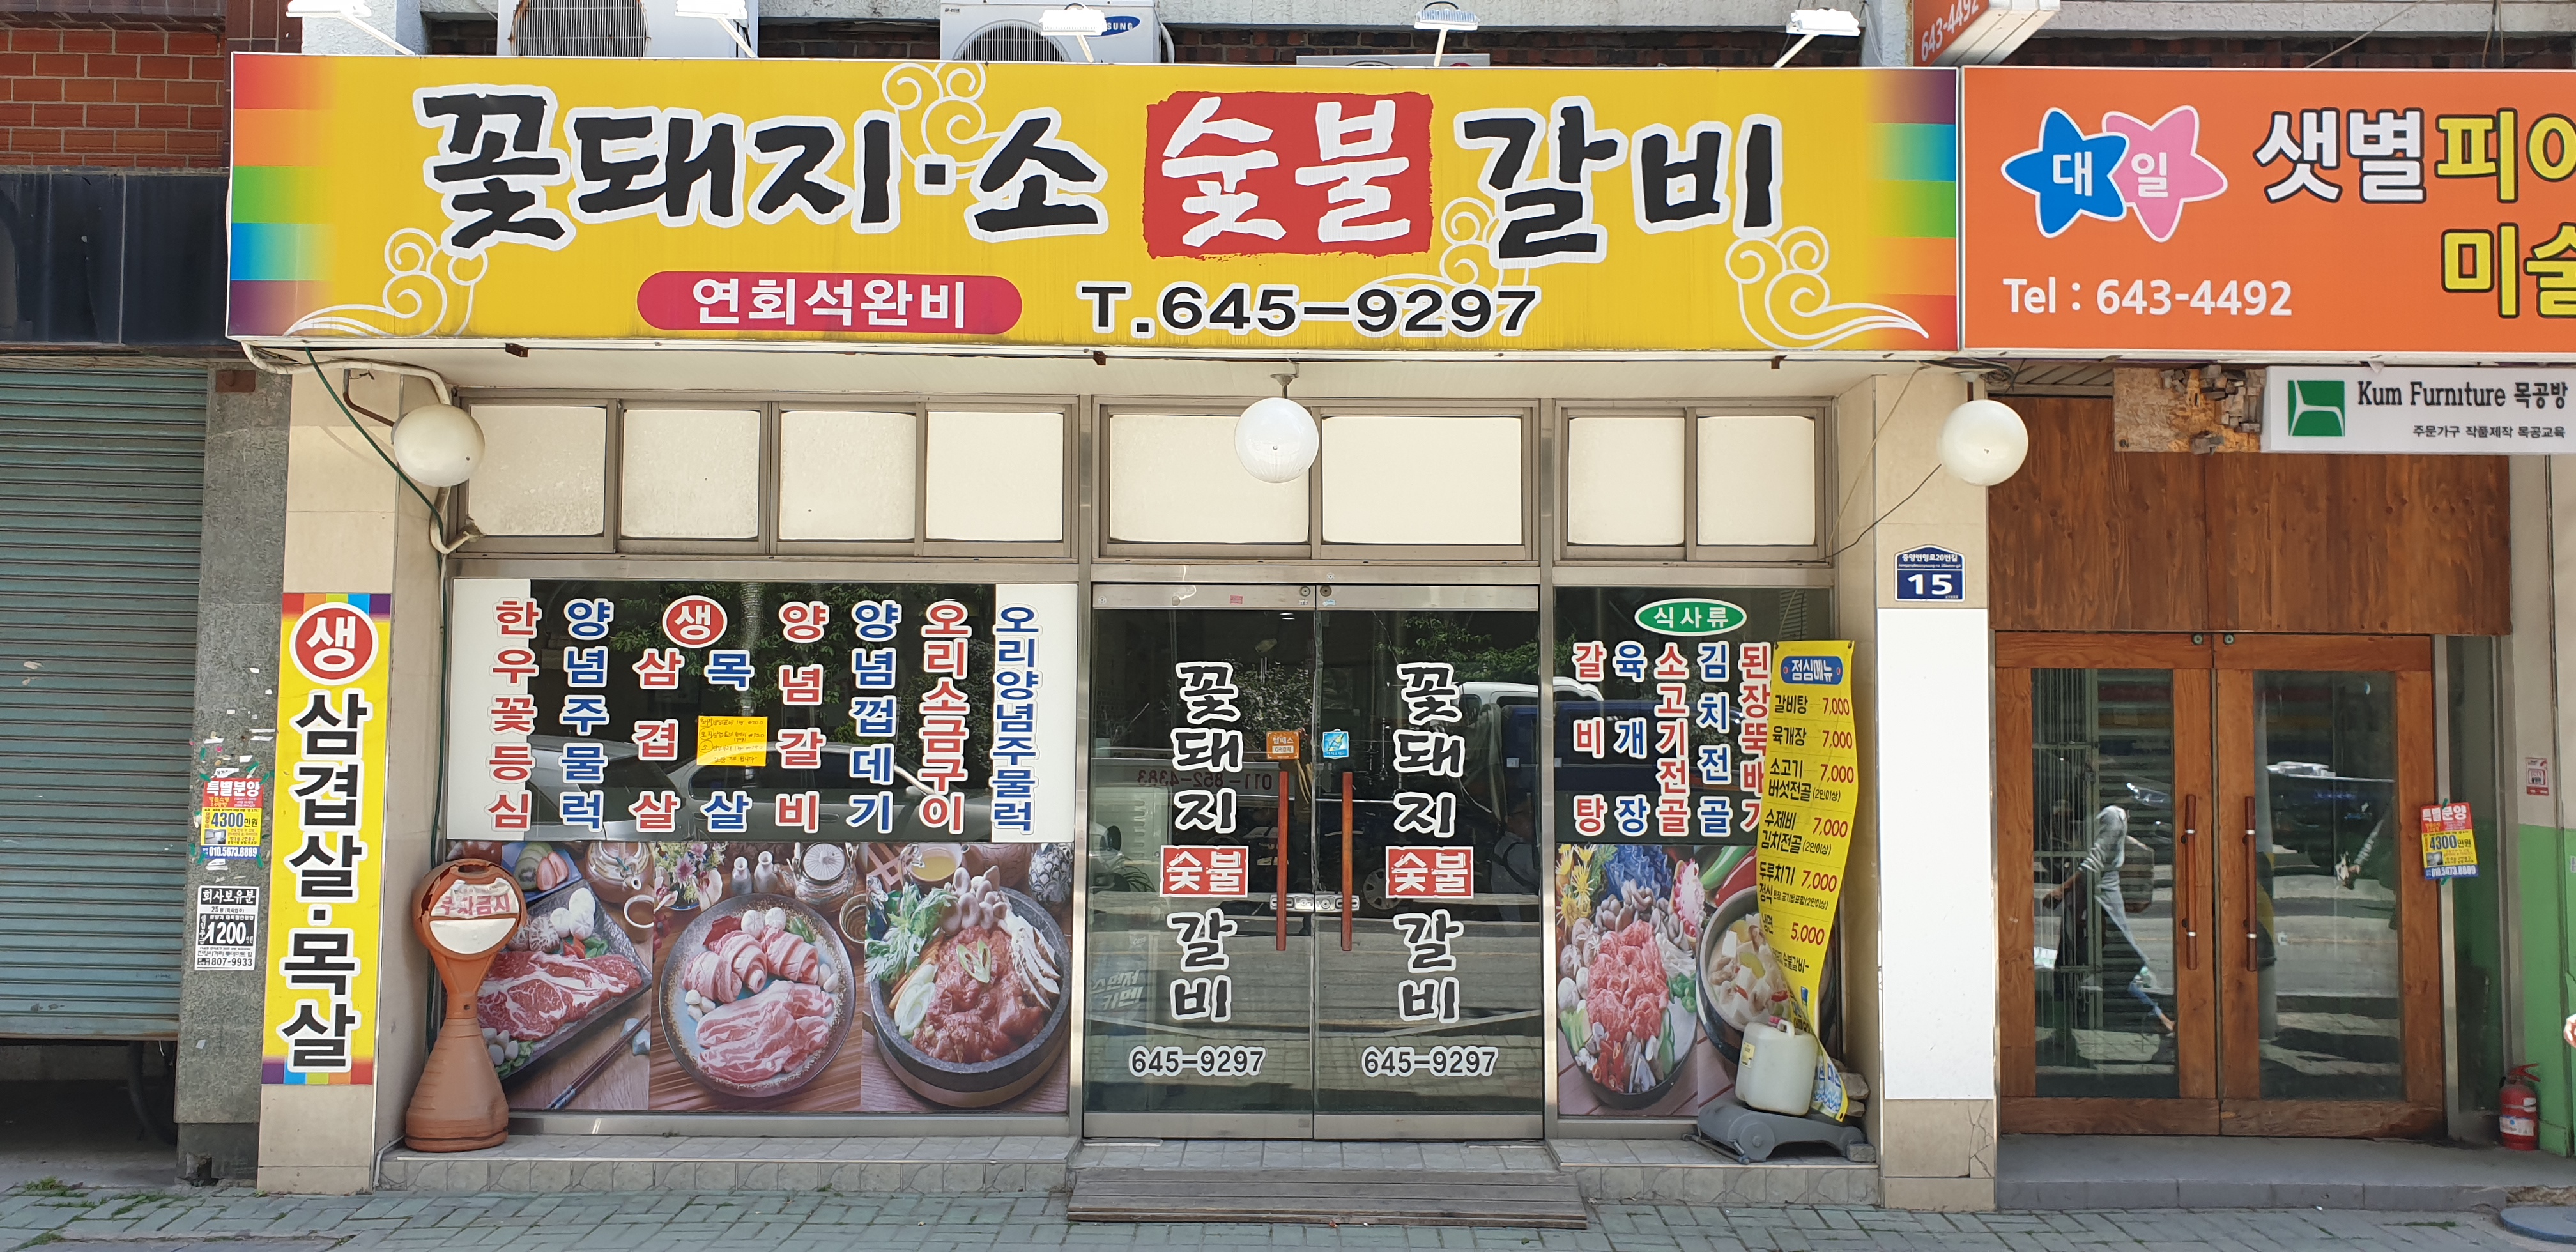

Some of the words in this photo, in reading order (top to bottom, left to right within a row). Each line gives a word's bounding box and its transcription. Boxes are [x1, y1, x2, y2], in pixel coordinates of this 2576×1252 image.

[1162, 96, 1411, 247] 숯불
[1460, 102, 1775, 261] 갈비
[693, 279, 965, 328] 연회석완비
[2096, 279, 2292, 316] 643-4492
[2358, 381, 2402, 406] Kum
[2514, 381, 2568, 409] 목공방
[2412, 425, 2461, 438] 주문가구
[2465, 425, 2513, 439] 작품제작
[2518, 426, 2566, 439] 목공교육
[1907, 574, 1952, 595] 15
[675, 604, 714, 641] 생
[1653, 606, 1729, 629] 식사류
[305, 615, 356, 673] 생
[1791, 659, 1833, 682] 점심메뉴
[487, 598, 541, 833] 한우꽃등심
[562, 598, 614, 830] 양념주물럭
[1775, 694, 1809, 714] 갈비탕
[1821, 697, 1850, 716] 7,000
[1772, 725, 1807, 747] 육개장
[1821, 729, 1853, 749] 7,000
[1769, 759, 1804, 779] 소고기
[1820, 763, 1855, 784] 7,000
[206, 780, 261, 797] 특별분양
[1768, 779, 1812, 802] 버섯전골
[1764, 808, 1797, 831] 수제비
[1812, 816, 1848, 838] 7,000
[1761, 830, 1802, 855] 김치전골
[1165, 850, 1246, 894] 숯불
[1392, 851, 1471, 896] 숯불
[1759, 861, 1796, 887] 두루치기
[1800, 869, 1837, 892] 7,000
[202, 889, 256, 905] 회사보유분
[1759, 883, 1774, 905] 정식
[1790, 922, 1825, 946] 5,000
[211, 958, 252, 966] 807-9933
[1130, 1048, 1266, 1074] 645-9297
[1363, 1048, 1498, 1076] 645-9297
